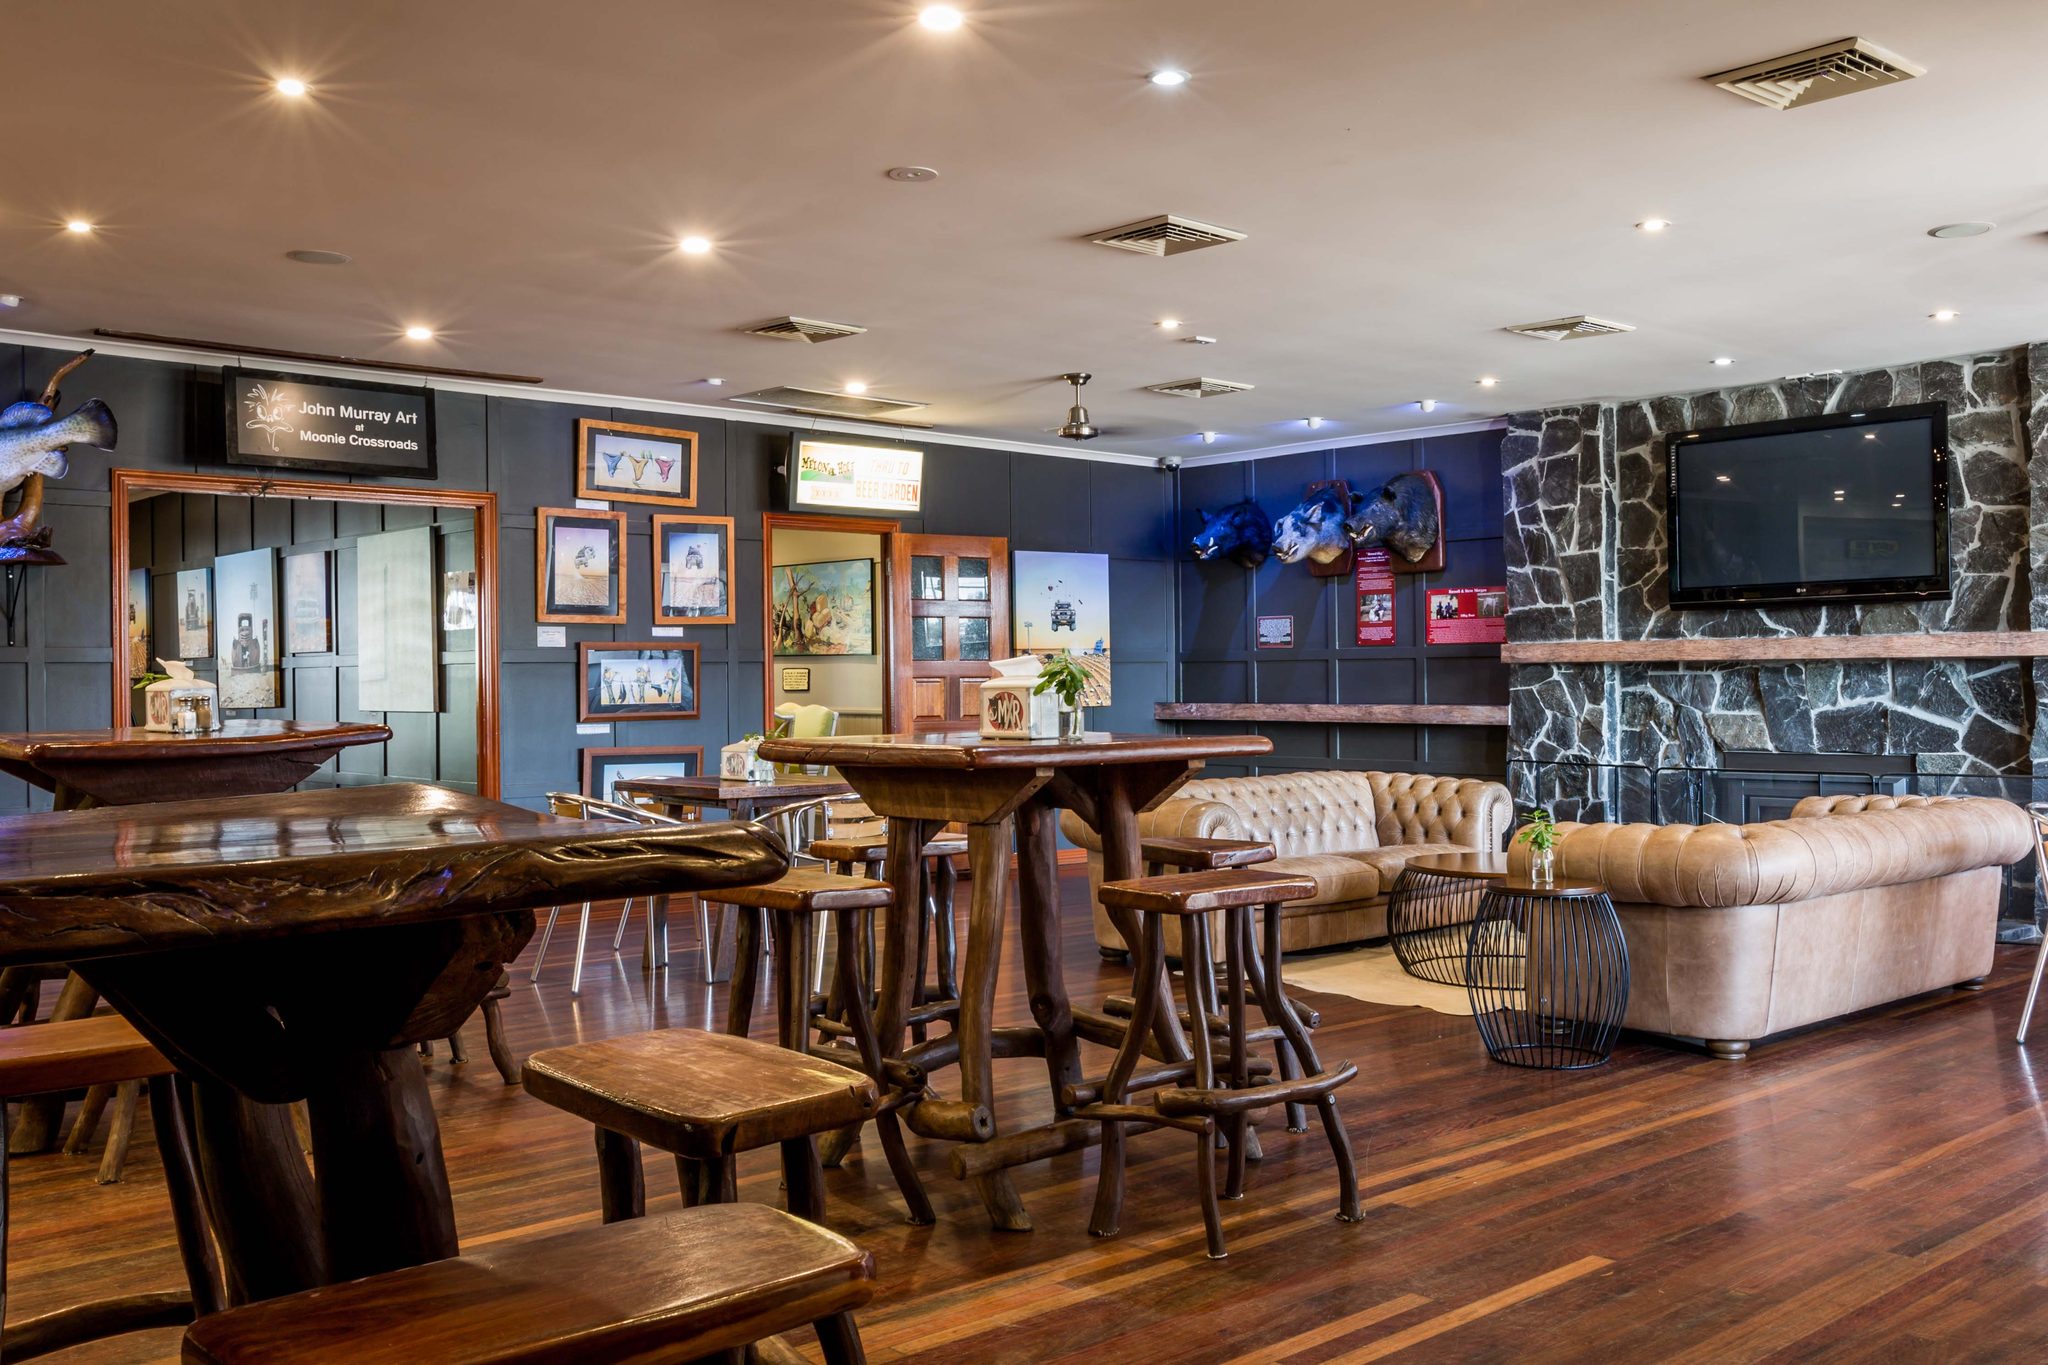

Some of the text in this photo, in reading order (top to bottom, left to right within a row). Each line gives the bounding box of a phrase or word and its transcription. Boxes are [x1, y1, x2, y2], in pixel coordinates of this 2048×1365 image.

[298, 401, 418, 425] John Murray Art
[355, 423, 365, 432] at
[300, 430, 418, 451] Moonie Crossroads
[898, 461, 910, 476] TO
[856, 480, 919, 503] BEER GARDEN
[998, 692, 1022, 731] MXR
